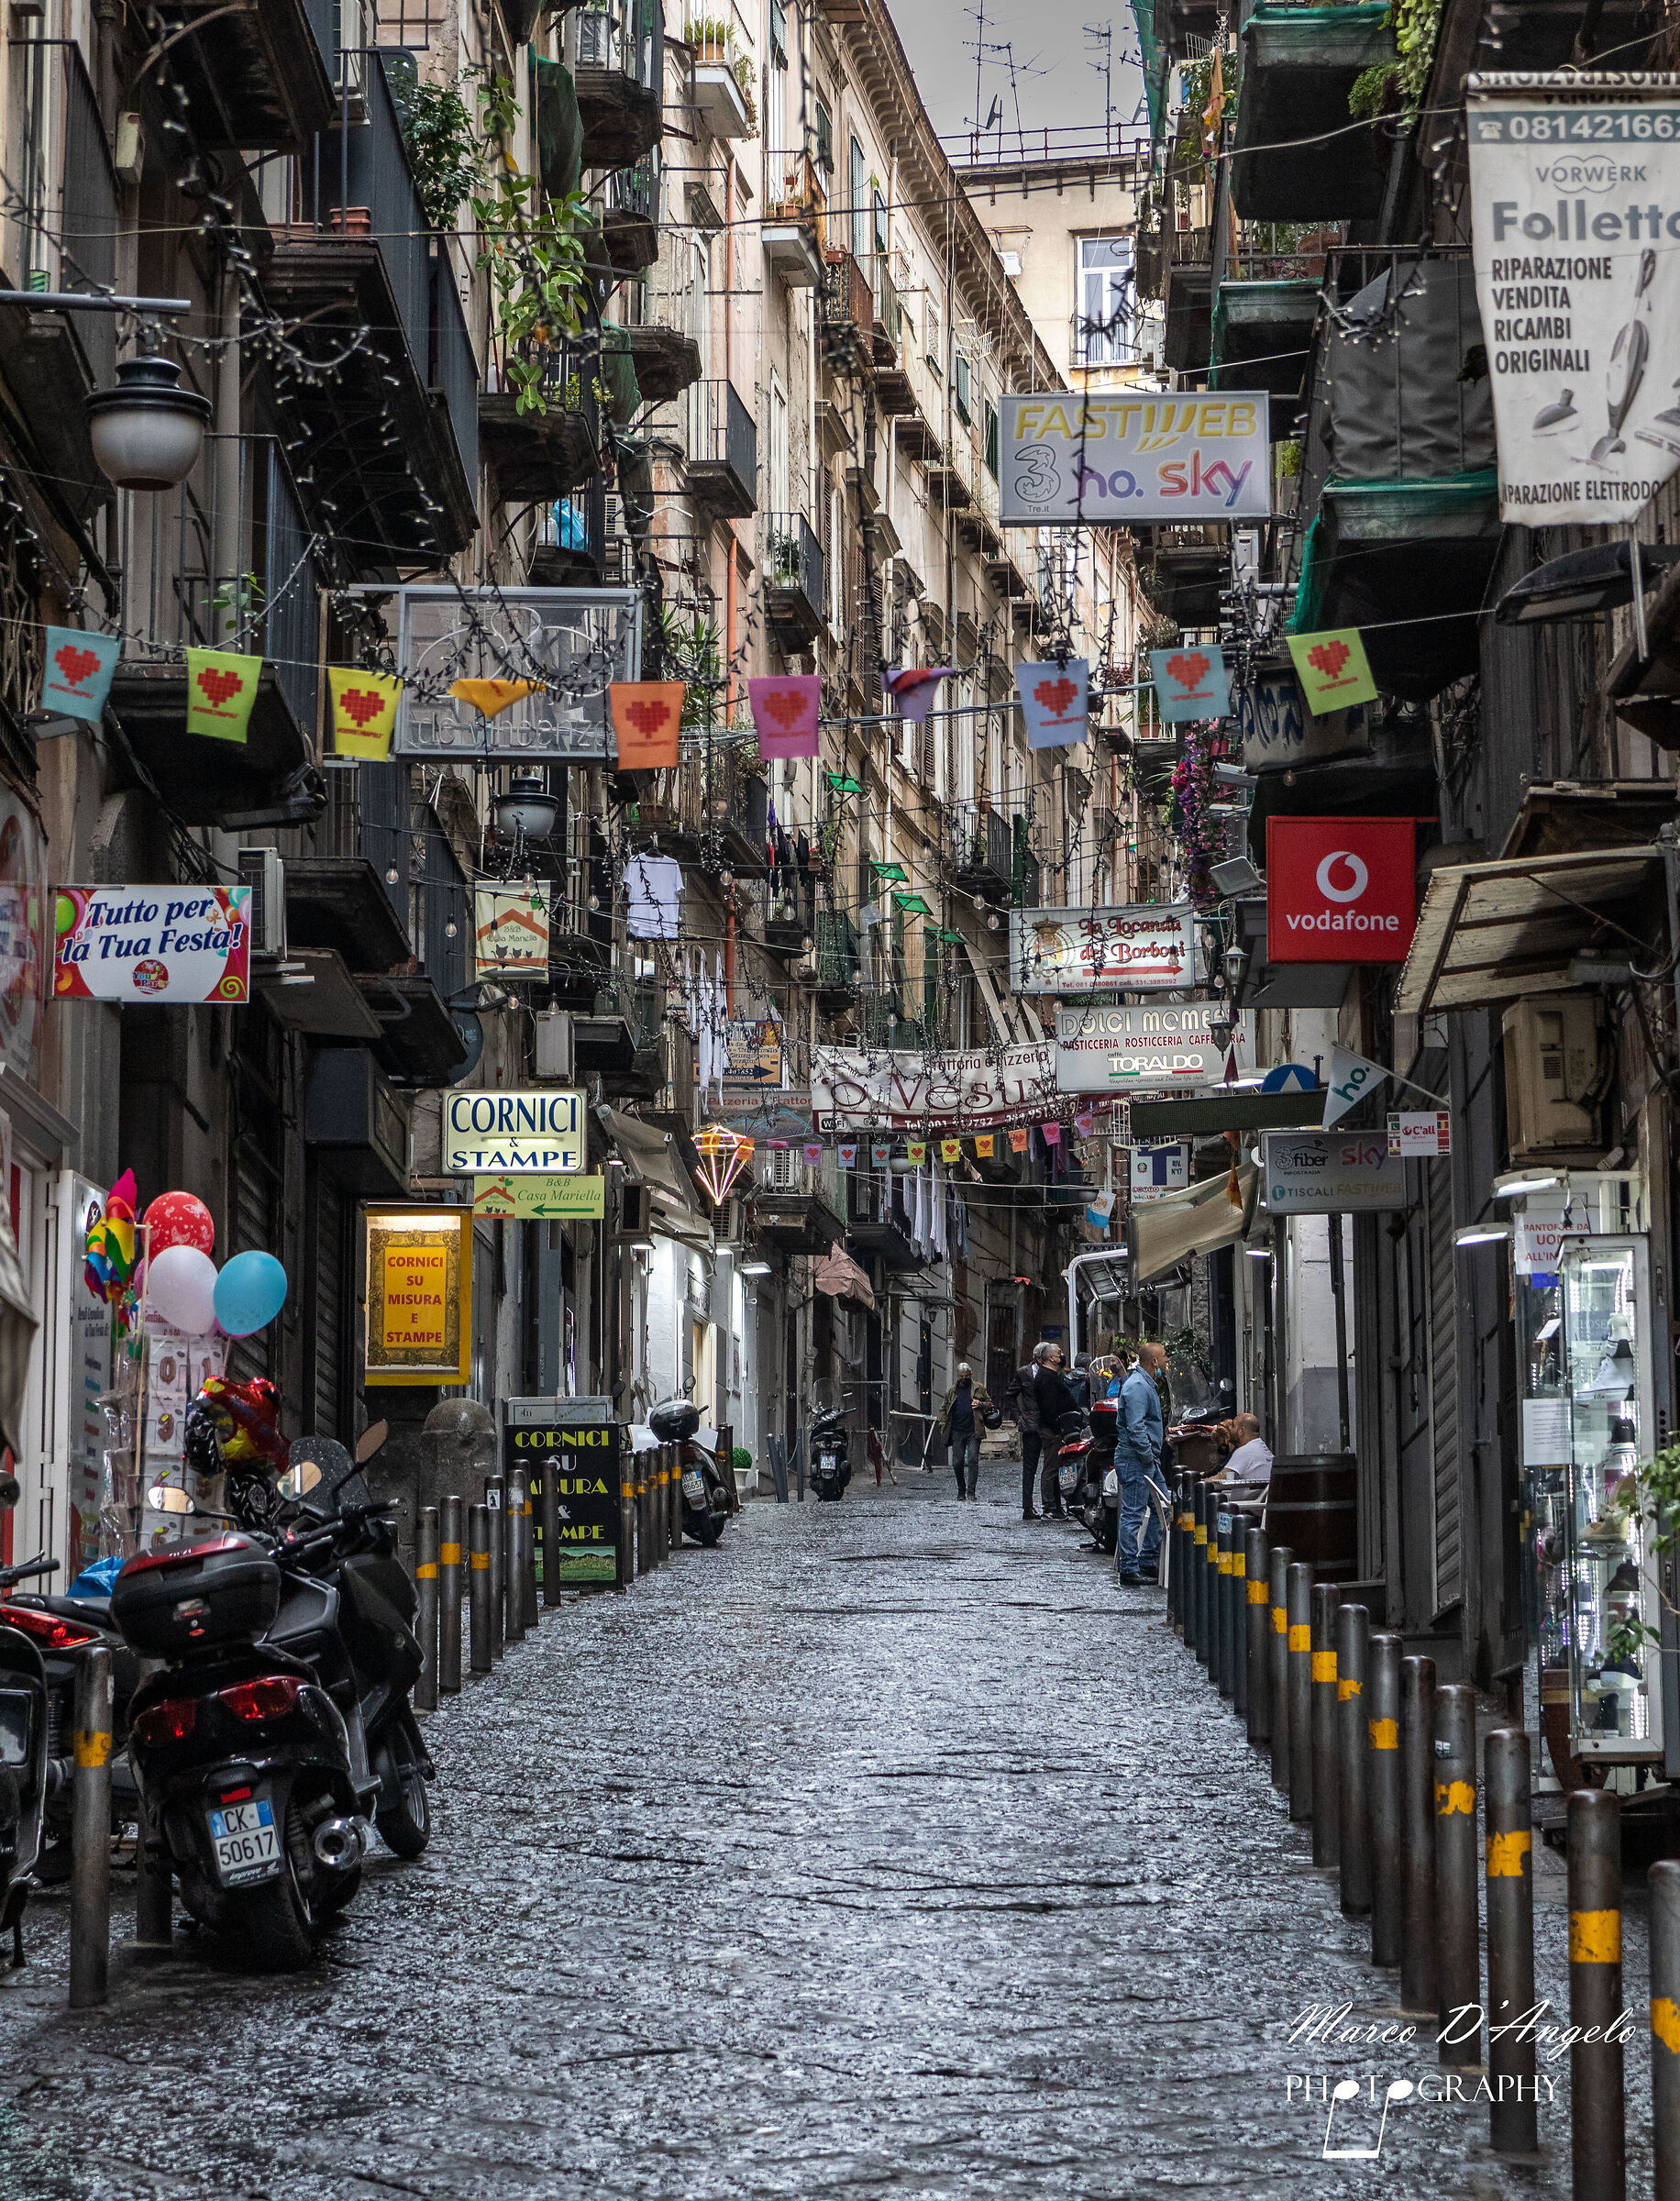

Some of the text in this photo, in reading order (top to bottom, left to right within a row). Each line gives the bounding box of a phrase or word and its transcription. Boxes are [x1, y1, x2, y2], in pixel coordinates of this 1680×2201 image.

[1509, 115, 1680, 139] 08142166
[1536, 165, 1647, 183] VORWERK
[1491, 256, 1612, 282] RIPARAZIONE
[1492, 286, 1571, 311] VENDITA
[1494, 316, 1571, 342] RICAMBI
[1495, 348, 1590, 375] ORIGINALI
[1014, 403, 1257, 449] FASTWEB
[1159, 449, 1253, 507] sky
[89, 899, 215, 927] Tutto per
[1287, 910, 1399, 931] vodafone
[62, 923, 243, 963] la Tua Festa!
[1061, 1011, 1131, 1035] DOLCI
[1124, 1035, 1183, 1048] ROSTICCERIA
[1107, 1053, 1204, 1072] TORALDO
[1332, 1066, 1371, 1101] ho.
[451, 1097, 577, 1133] CORNICI
[1412, 1125, 1436, 1134] C'all
[509, 1136, 519, 1147] &
[452, 1151, 577, 1167] STAMPE
[1293, 1153, 1328, 1167] fiber
[1342, 1141, 1388, 1170] sky
[546, 1178, 570, 1187] B&B
[1288, 1187, 1332, 1197] TISCALI
[517, 1189, 602, 1200] Casa Mariella
[387, 1256, 444, 1267] CORNICI
[406, 1275, 424, 1287] SU
[388, 1294, 442, 1305] MISURA
[411, 1313, 418, 1323] E
[386, 1332, 442, 1343] STAMPE
[514, 1431, 609, 1448] CORNICI
[558, 1505, 571, 1520] &
[224, 1807, 249, 1833] CK
[219, 1830, 274, 1865] 50617
